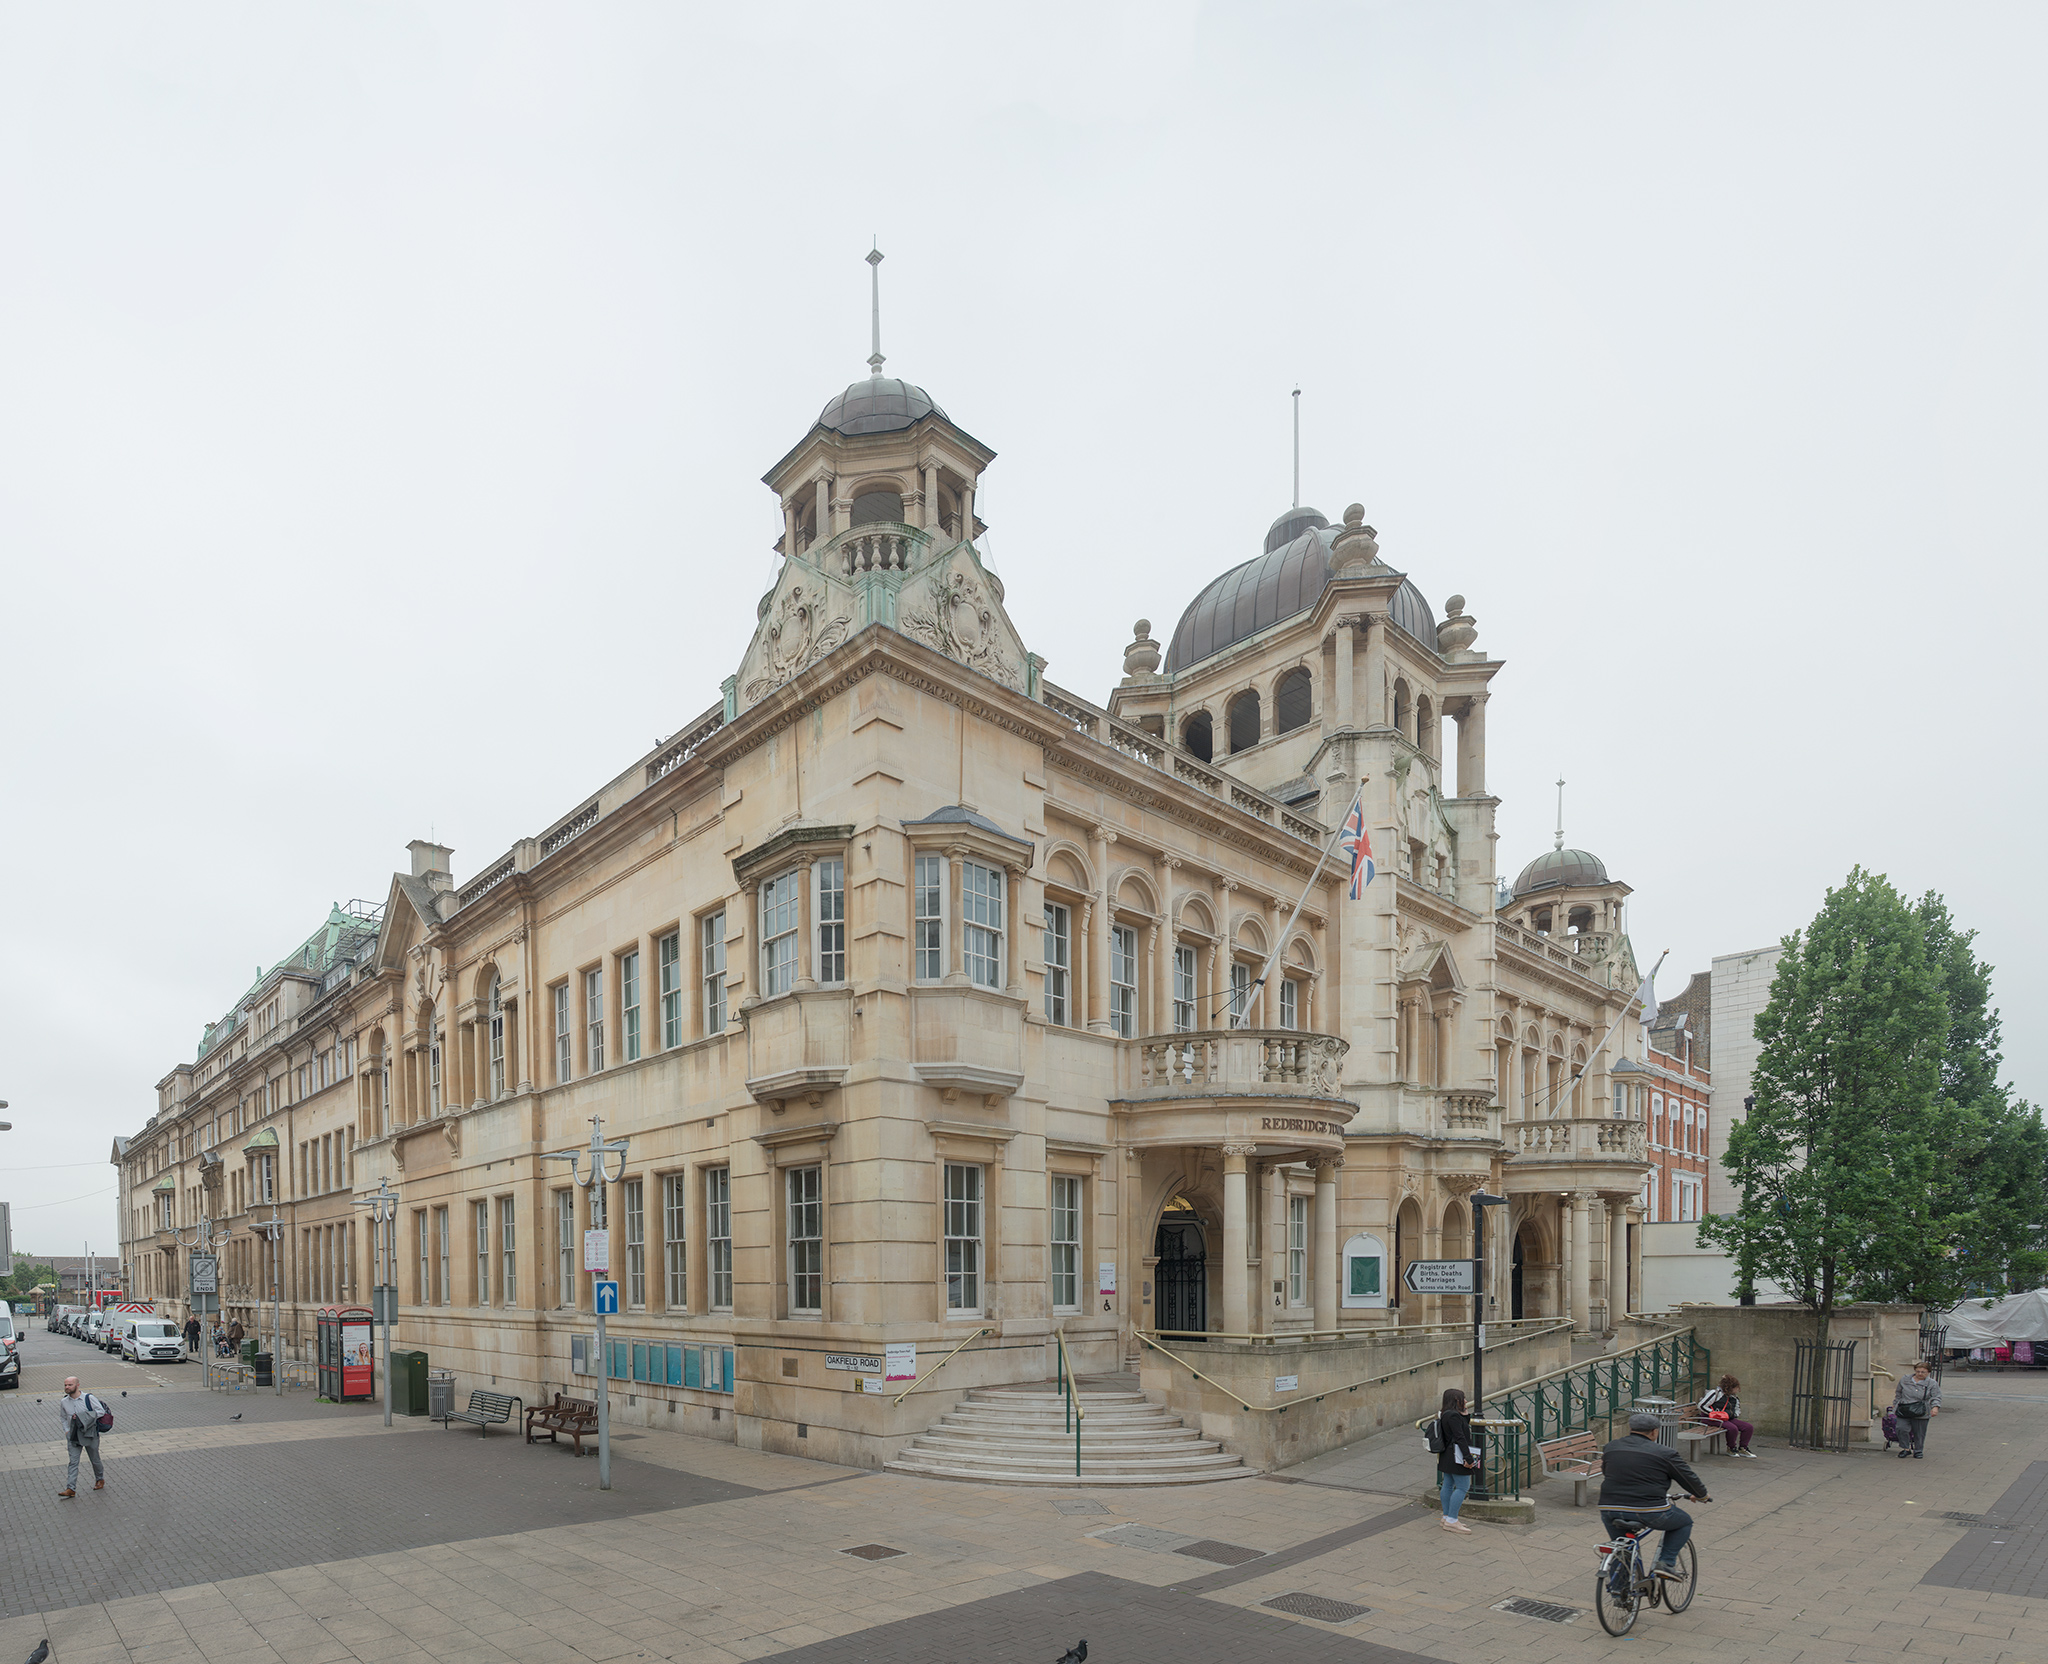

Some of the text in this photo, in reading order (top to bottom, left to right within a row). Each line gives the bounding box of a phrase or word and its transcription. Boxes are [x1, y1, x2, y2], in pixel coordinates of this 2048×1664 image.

[1261, 1117, 1328, 1133] REDBRIDGE
[827, 1356, 879, 1368] OAKFIELD ROAD
